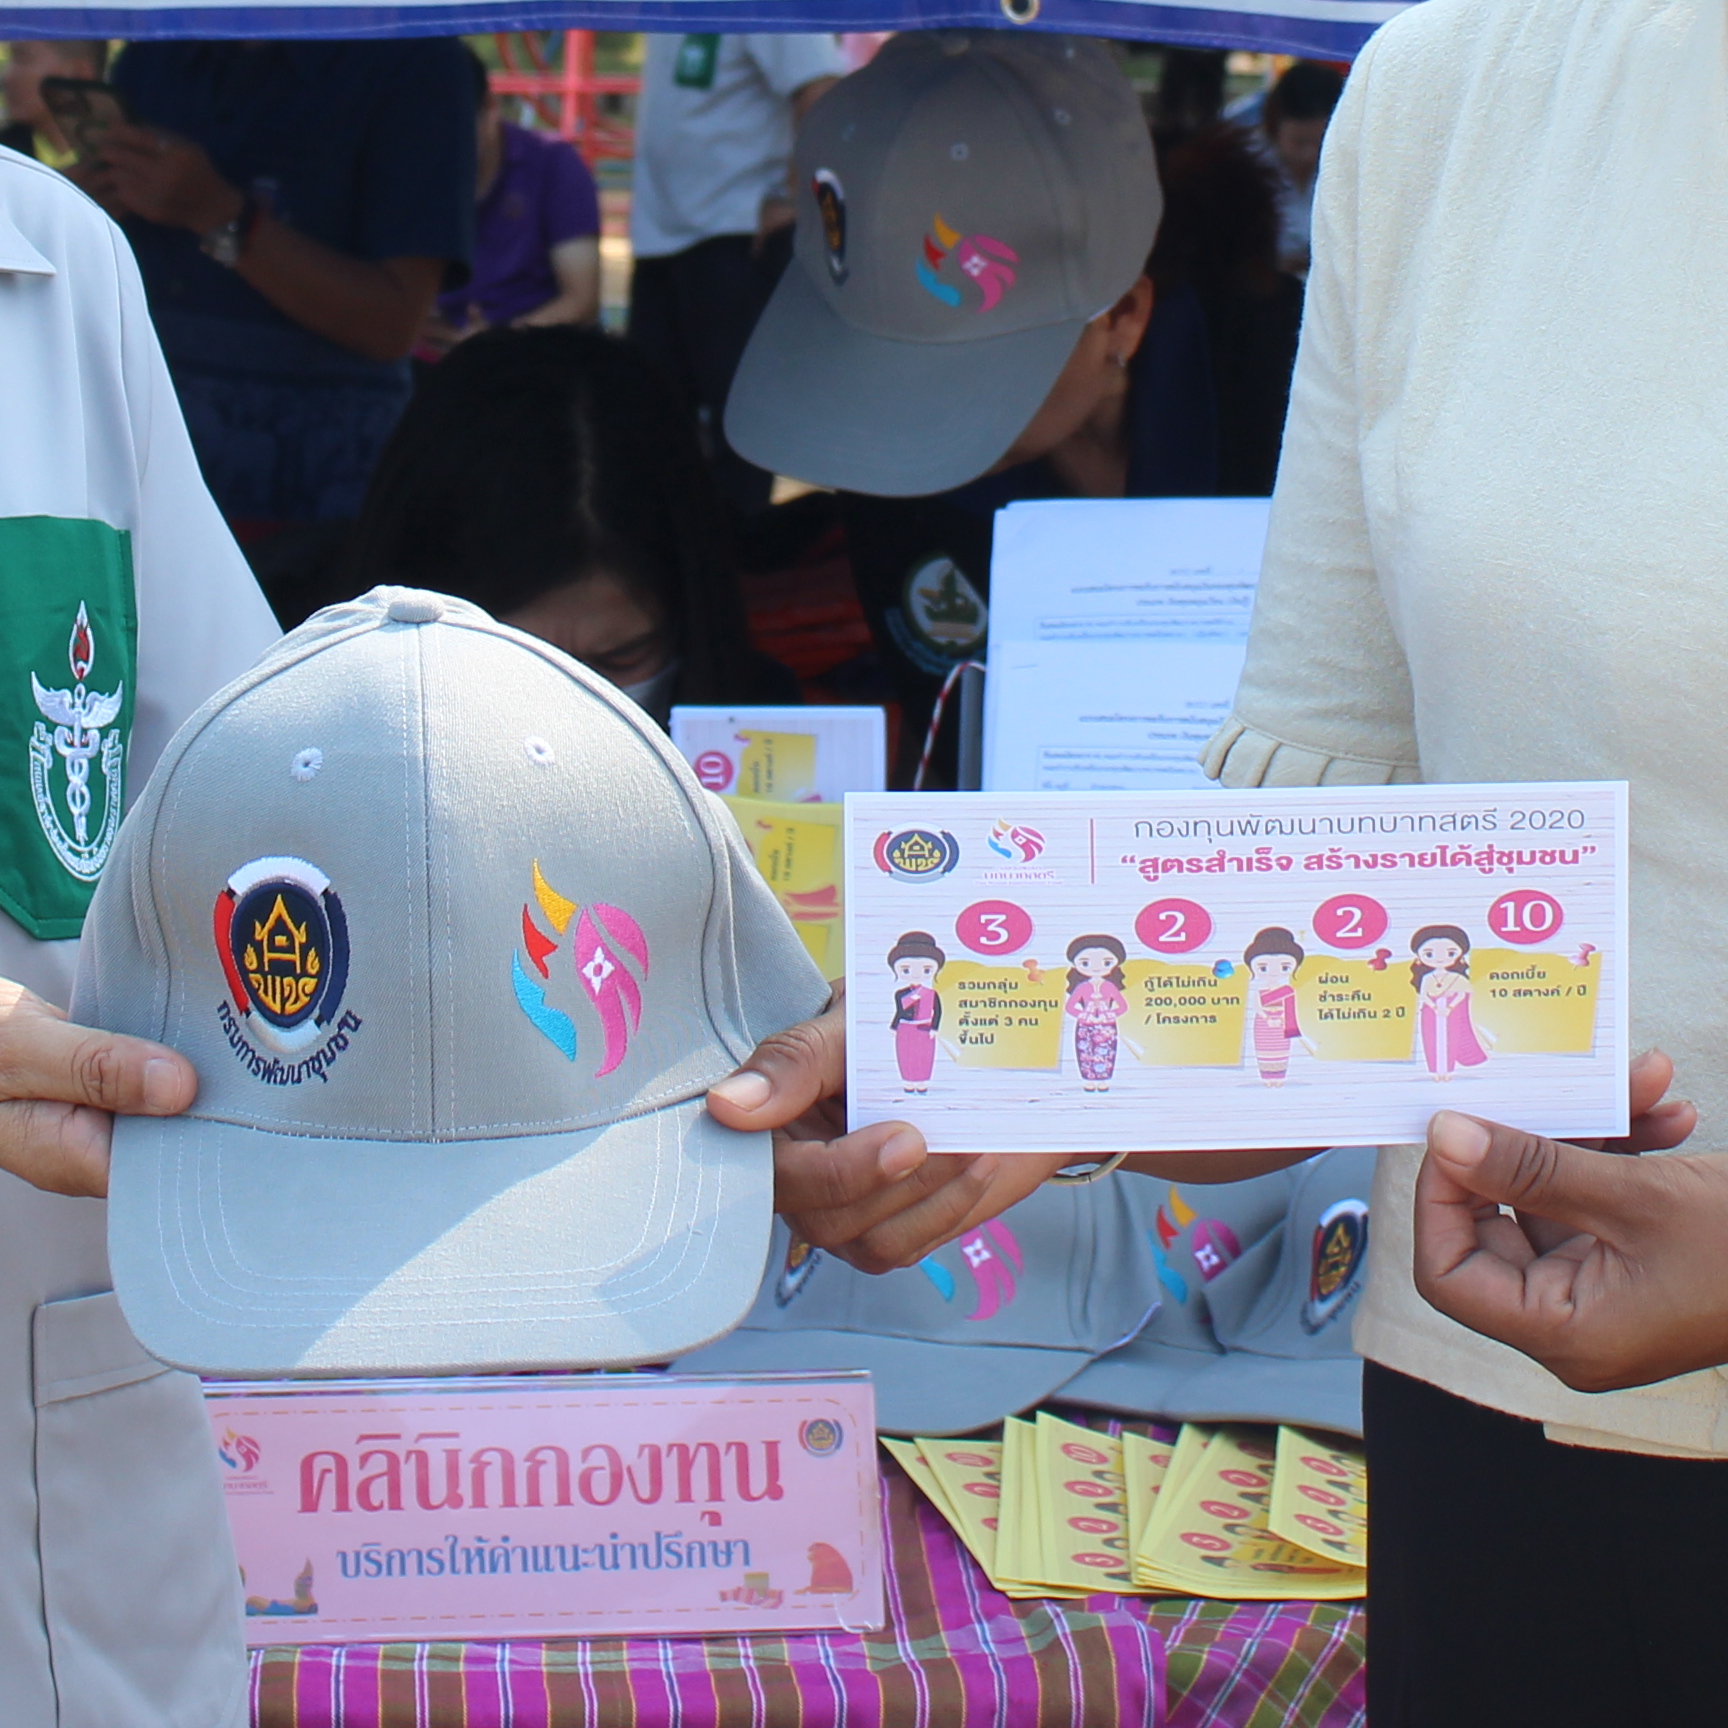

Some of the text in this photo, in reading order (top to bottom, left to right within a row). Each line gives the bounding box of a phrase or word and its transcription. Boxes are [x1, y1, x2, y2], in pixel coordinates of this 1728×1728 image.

[1133, 807, 1586, 844] กองทุนพัฒนาบทบาทสตรี 2020
[1334, 906, 1364, 938] 2
[1498, 900, 1555, 932] 10
[979, 913, 1010, 946] 3
[1157, 910, 1187, 943] 2
[1317, 971, 1350, 985] ผ่อน
[1488, 964, 1547, 981] ดอกเบี้ย
[957, 977, 1019, 994] รวมกลุ่ม
[1143, 975, 1219, 993] กู้ได้ไม่เกิน
[1489, 987, 1509, 999] 10
[1511, 984, 1563, 999] สตางค์
[1576, 984, 1588, 997] ปี
[958, 997, 1059, 1012] สมาชิกกองทุน
[1144, 995, 1240, 1009] 200,000 บาท
[1318, 989, 1373, 1003] ชำระคืน
[1003, 1016, 1014, 1027] 3
[1017, 1016, 1039, 1027] คน
[1155, 1012, 1218, 1026] โครงการ
[1317, 1006, 1406, 1021] ได้ไม่เกิน 2 ปี
[216, 999, 364, 1087] กรมการพัฒนาชุมชน
[296, 1430, 785, 1527] คลินิกกองทุน
[336, 1530, 753, 1580] บริการให้คำแนะนำปรึกษา
